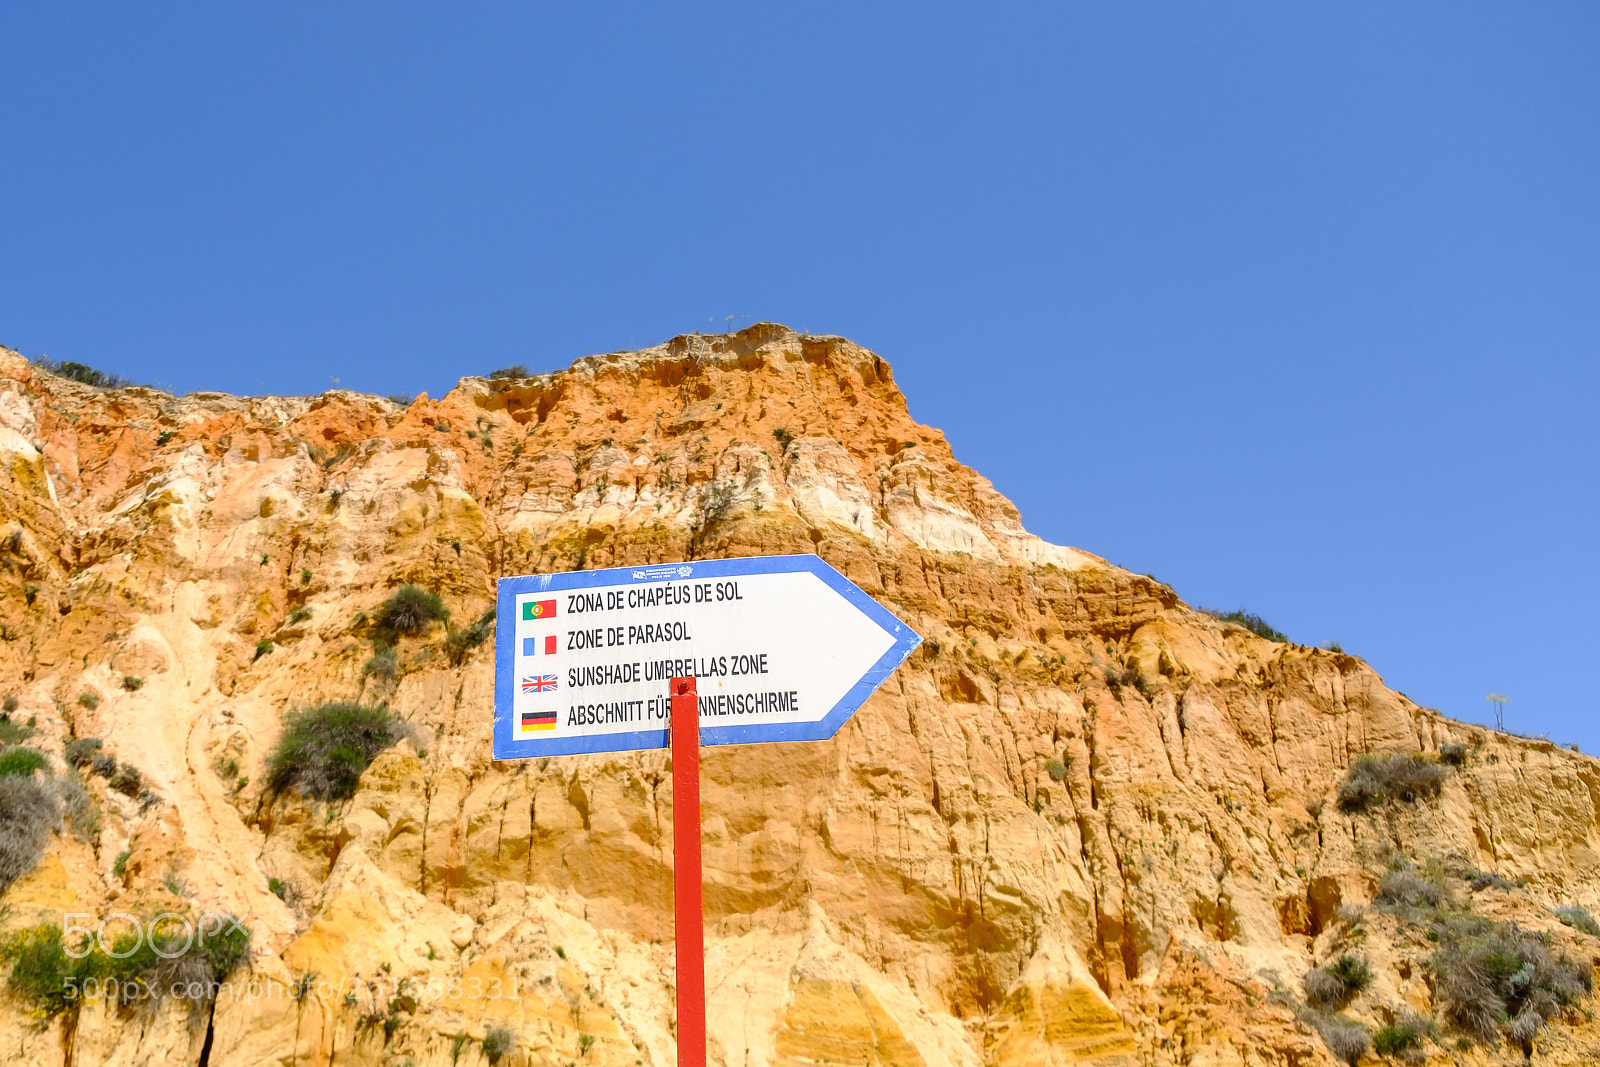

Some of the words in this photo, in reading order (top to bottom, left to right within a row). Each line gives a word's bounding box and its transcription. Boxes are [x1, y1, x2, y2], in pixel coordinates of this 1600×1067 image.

[567, 592, 604, 614] ZONA
[607, 590, 624, 611] DE
[628, 582, 691, 609] CHAPÉUS
[695, 583, 712, 603] DE
[716, 581, 743, 602] SOL
[567, 628, 603, 651] ZONE
[607, 626, 624, 647] DE
[628, 621, 691, 645] PARASOL
[568, 663, 640, 688] SUNSHADE
[644, 656, 727, 681] UMBRELLAS
[731, 653, 768, 676] ZONE
[567, 700, 643, 727] ABSCHNITT
[698, 690, 799, 717] NNENSCHIRME
